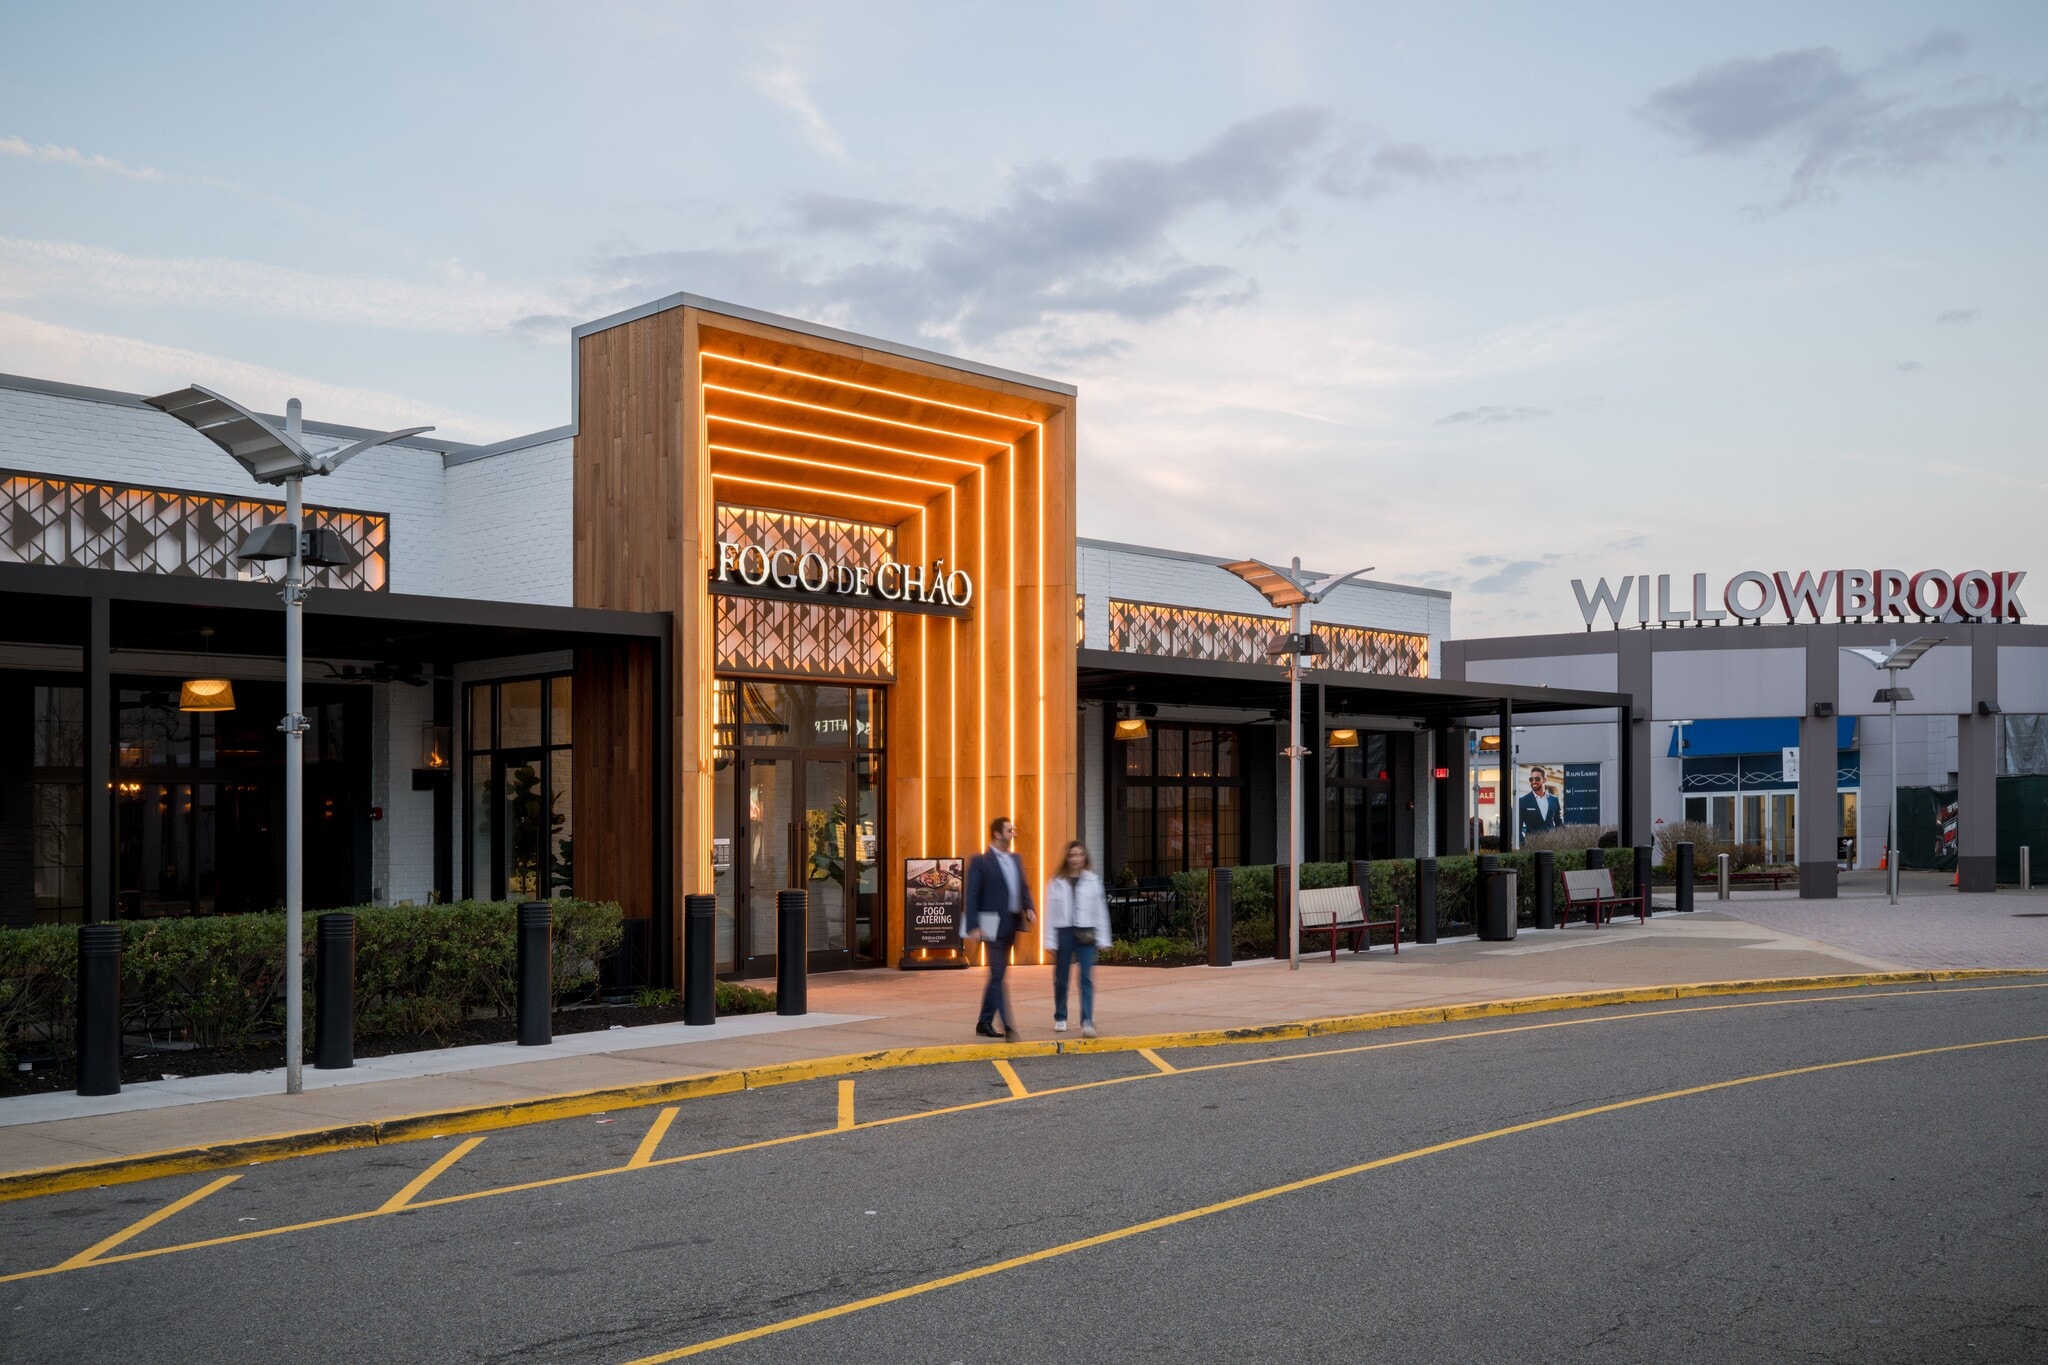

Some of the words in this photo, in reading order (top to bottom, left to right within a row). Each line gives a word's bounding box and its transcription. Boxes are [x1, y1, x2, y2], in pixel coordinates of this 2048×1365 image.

[717, 541, 829, 592] FOGO
[836, 565, 870, 596] DE
[876, 557, 973, 607] CHÃO
[1570, 569, 2027, 625] WILLOWBROOK
[915, 915, 952, 924] CATERING
[923, 907, 945, 915] FOGO
